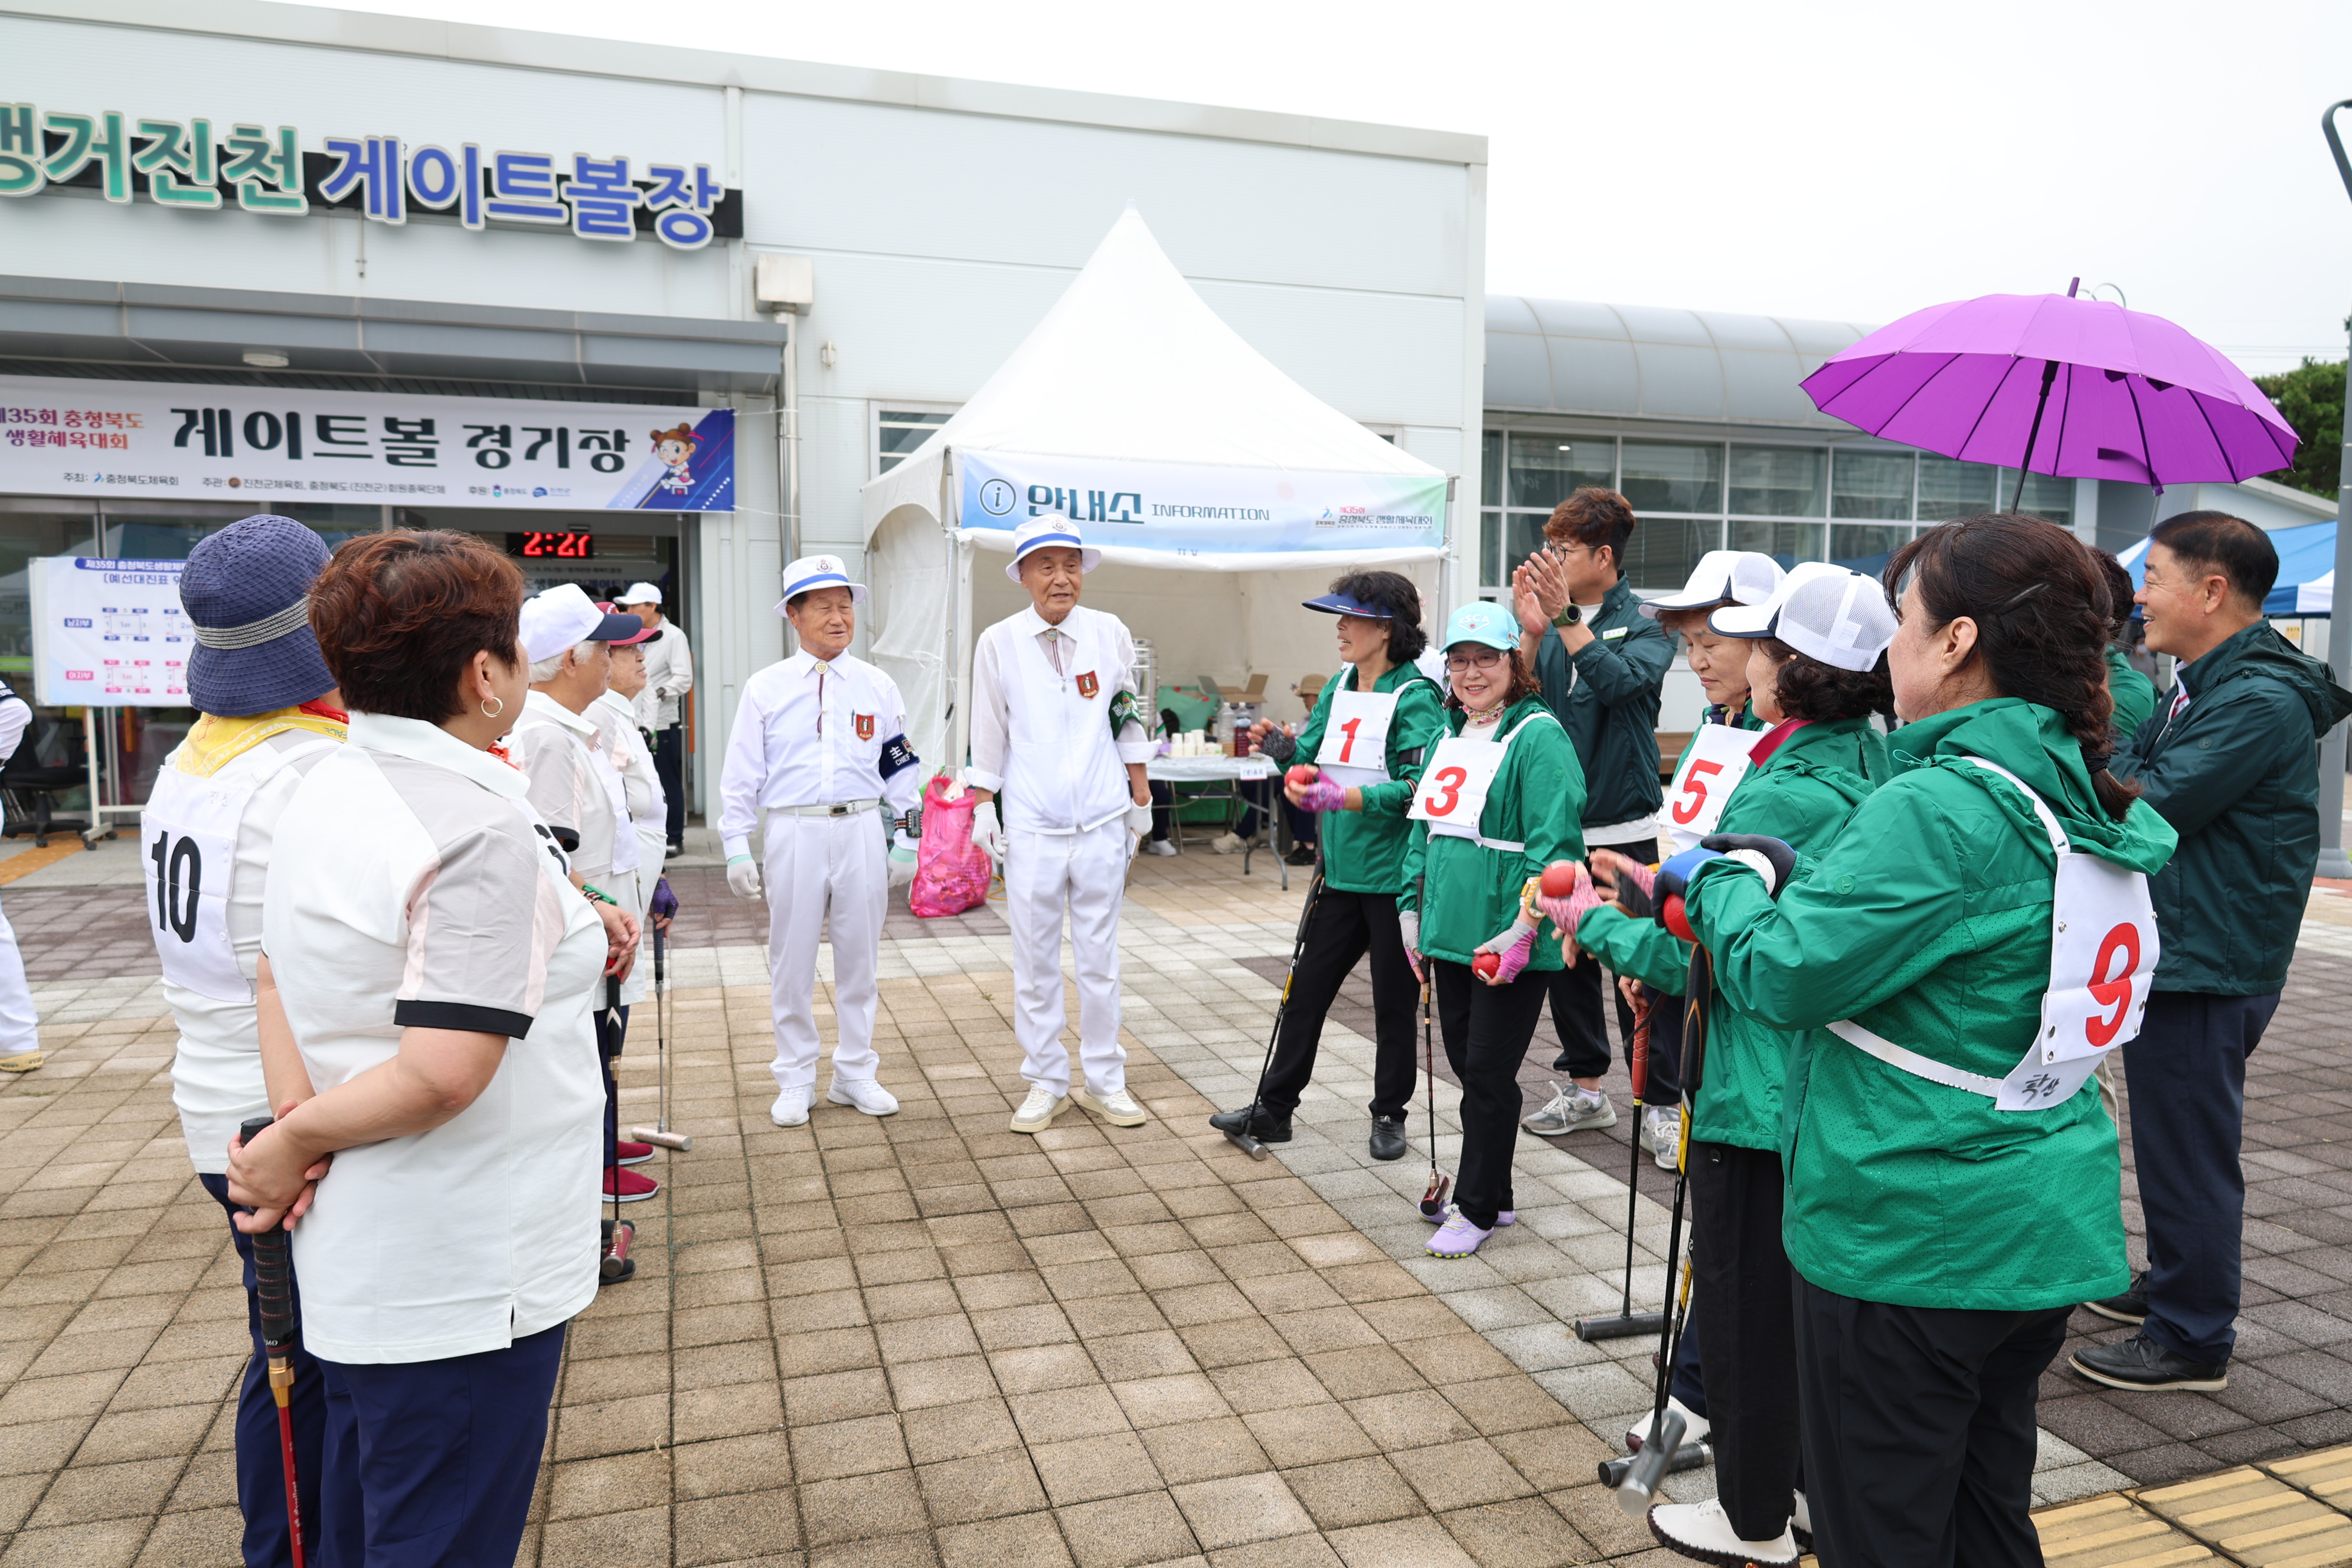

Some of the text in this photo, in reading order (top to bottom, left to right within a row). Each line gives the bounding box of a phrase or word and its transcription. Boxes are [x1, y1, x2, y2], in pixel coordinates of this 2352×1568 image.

[318, 135, 724, 249] 게이트볼장
[64, 410, 145, 429] 충청북도
[6, 429, 129, 450] 생활체육대회
[170, 407, 630, 473] 게이트볼 경기장
[64, 473, 88, 483] 주최:
[106, 474, 179, 485] 충청북도체육회
[1027, 484, 1145, 524] 안내소
[1151, 504, 1270, 521] INFORMATION
[1339, 506, 1366, 514] 제35회
[1338, 515, 1433, 525] 충청북도 생활체육대회
[523, 531, 591, 557] 2:27
[85, 559, 116, 569] 제35회
[233, 734, 257, 752] STOP
[1340, 717, 1361, 763] 1
[889, 746, 903, 759] 主
[895, 753, 910, 766] CHIEF
[208, 790, 231, 806] 진천
[1424, 766, 1468, 817] 3
[1672, 759, 1724, 825] 5
[151, 829, 201, 943] 10
[2085, 922, 2140, 1047] 9
